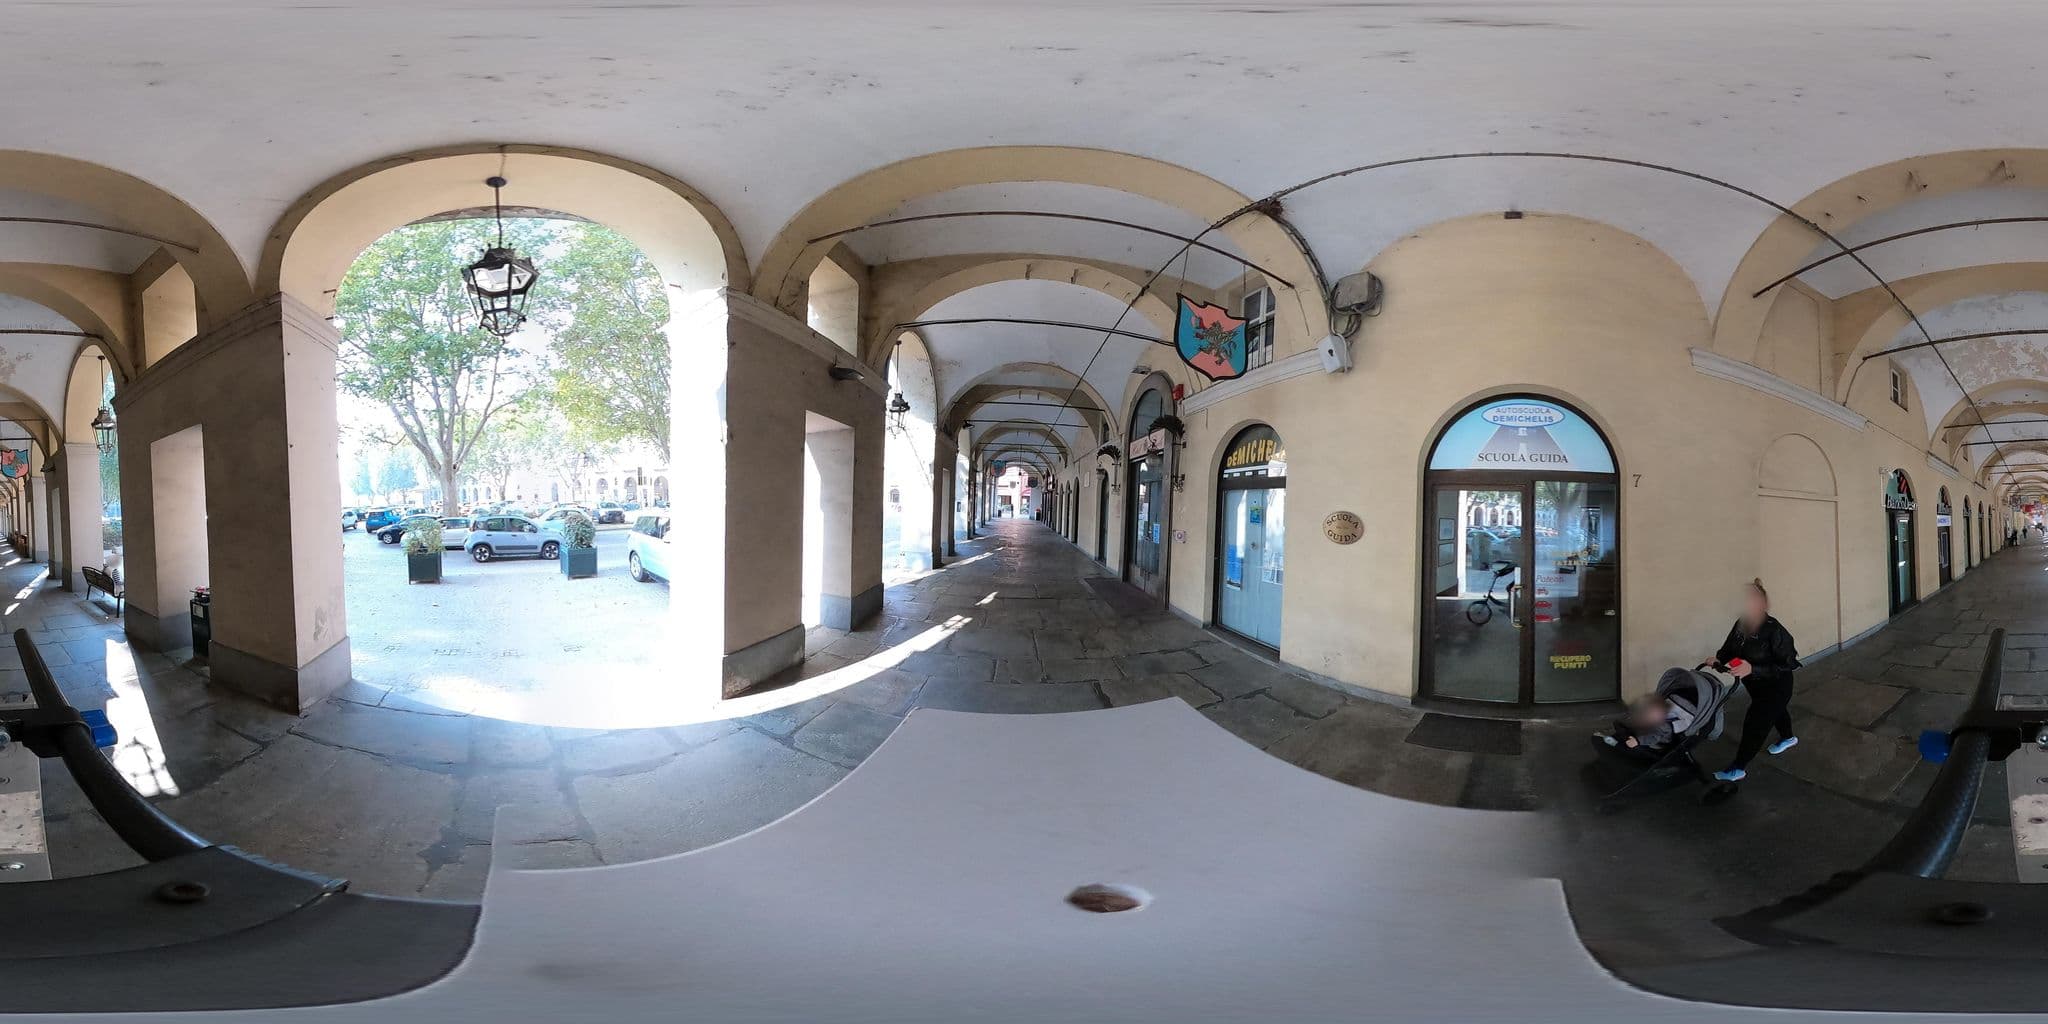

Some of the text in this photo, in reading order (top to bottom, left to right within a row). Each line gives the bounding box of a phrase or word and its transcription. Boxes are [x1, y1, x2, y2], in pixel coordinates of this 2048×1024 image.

[1493, 415, 1554, 423] DEMICHELIS
[1478, 452, 1568, 463] SCUOLA GUIDA
[1632, 473, 1642, 488] 7
[1326, 514, 1359, 528] SCUOLA
[1327, 529, 1357, 542] GUIDA
